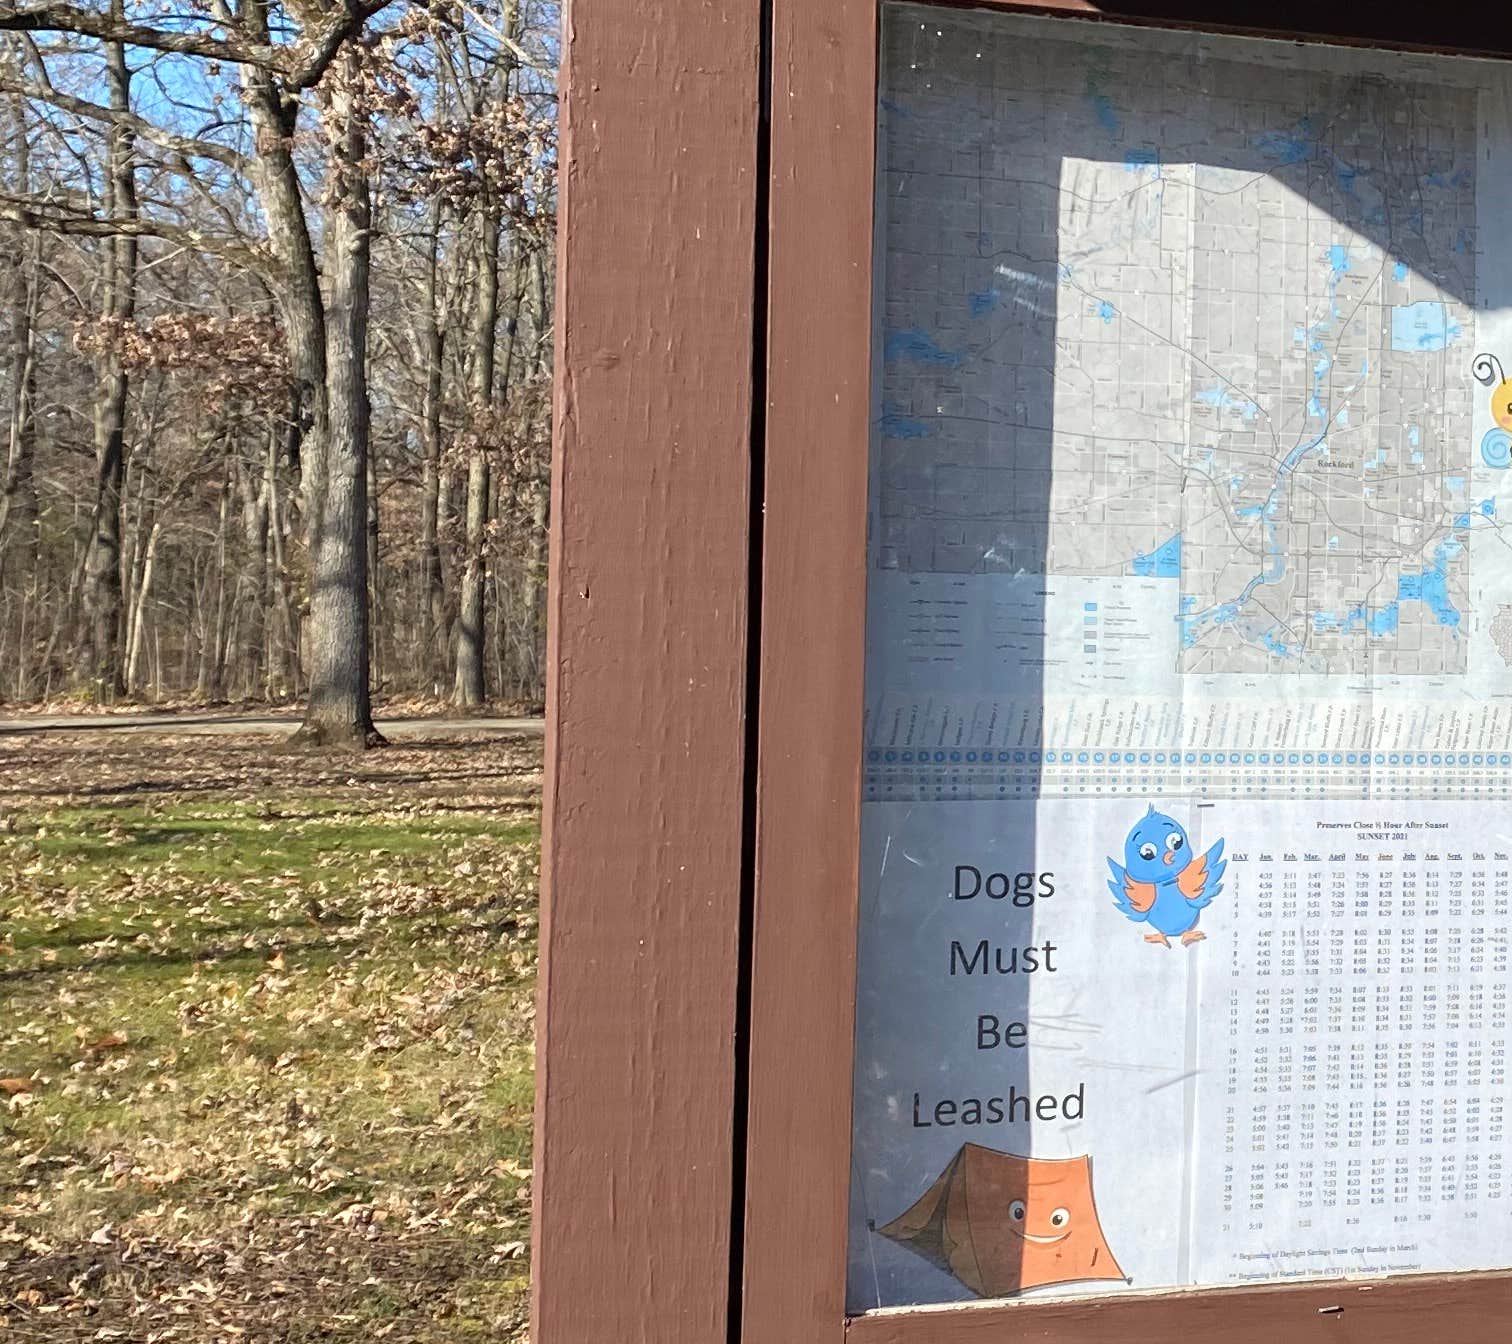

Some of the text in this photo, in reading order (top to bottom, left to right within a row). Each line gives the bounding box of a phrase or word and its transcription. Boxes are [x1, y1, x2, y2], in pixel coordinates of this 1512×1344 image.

[1318, 460, 1354, 468] Rockford
[1353, 821, 1373, 829] Close
[1405, 821, 1422, 829] After
[1232, 853, 1249, 861] DAY
[1329, 853, 1346, 861] April
[1355, 853, 1369, 861] May
[1378, 853, 1393, 861] June
[953, 864, 1056, 907] Dogs
[950, 939, 1058, 976] Must
[977, 1015, 1027, 1050] Be
[913, 1083, 1085, 1128] Leashed
